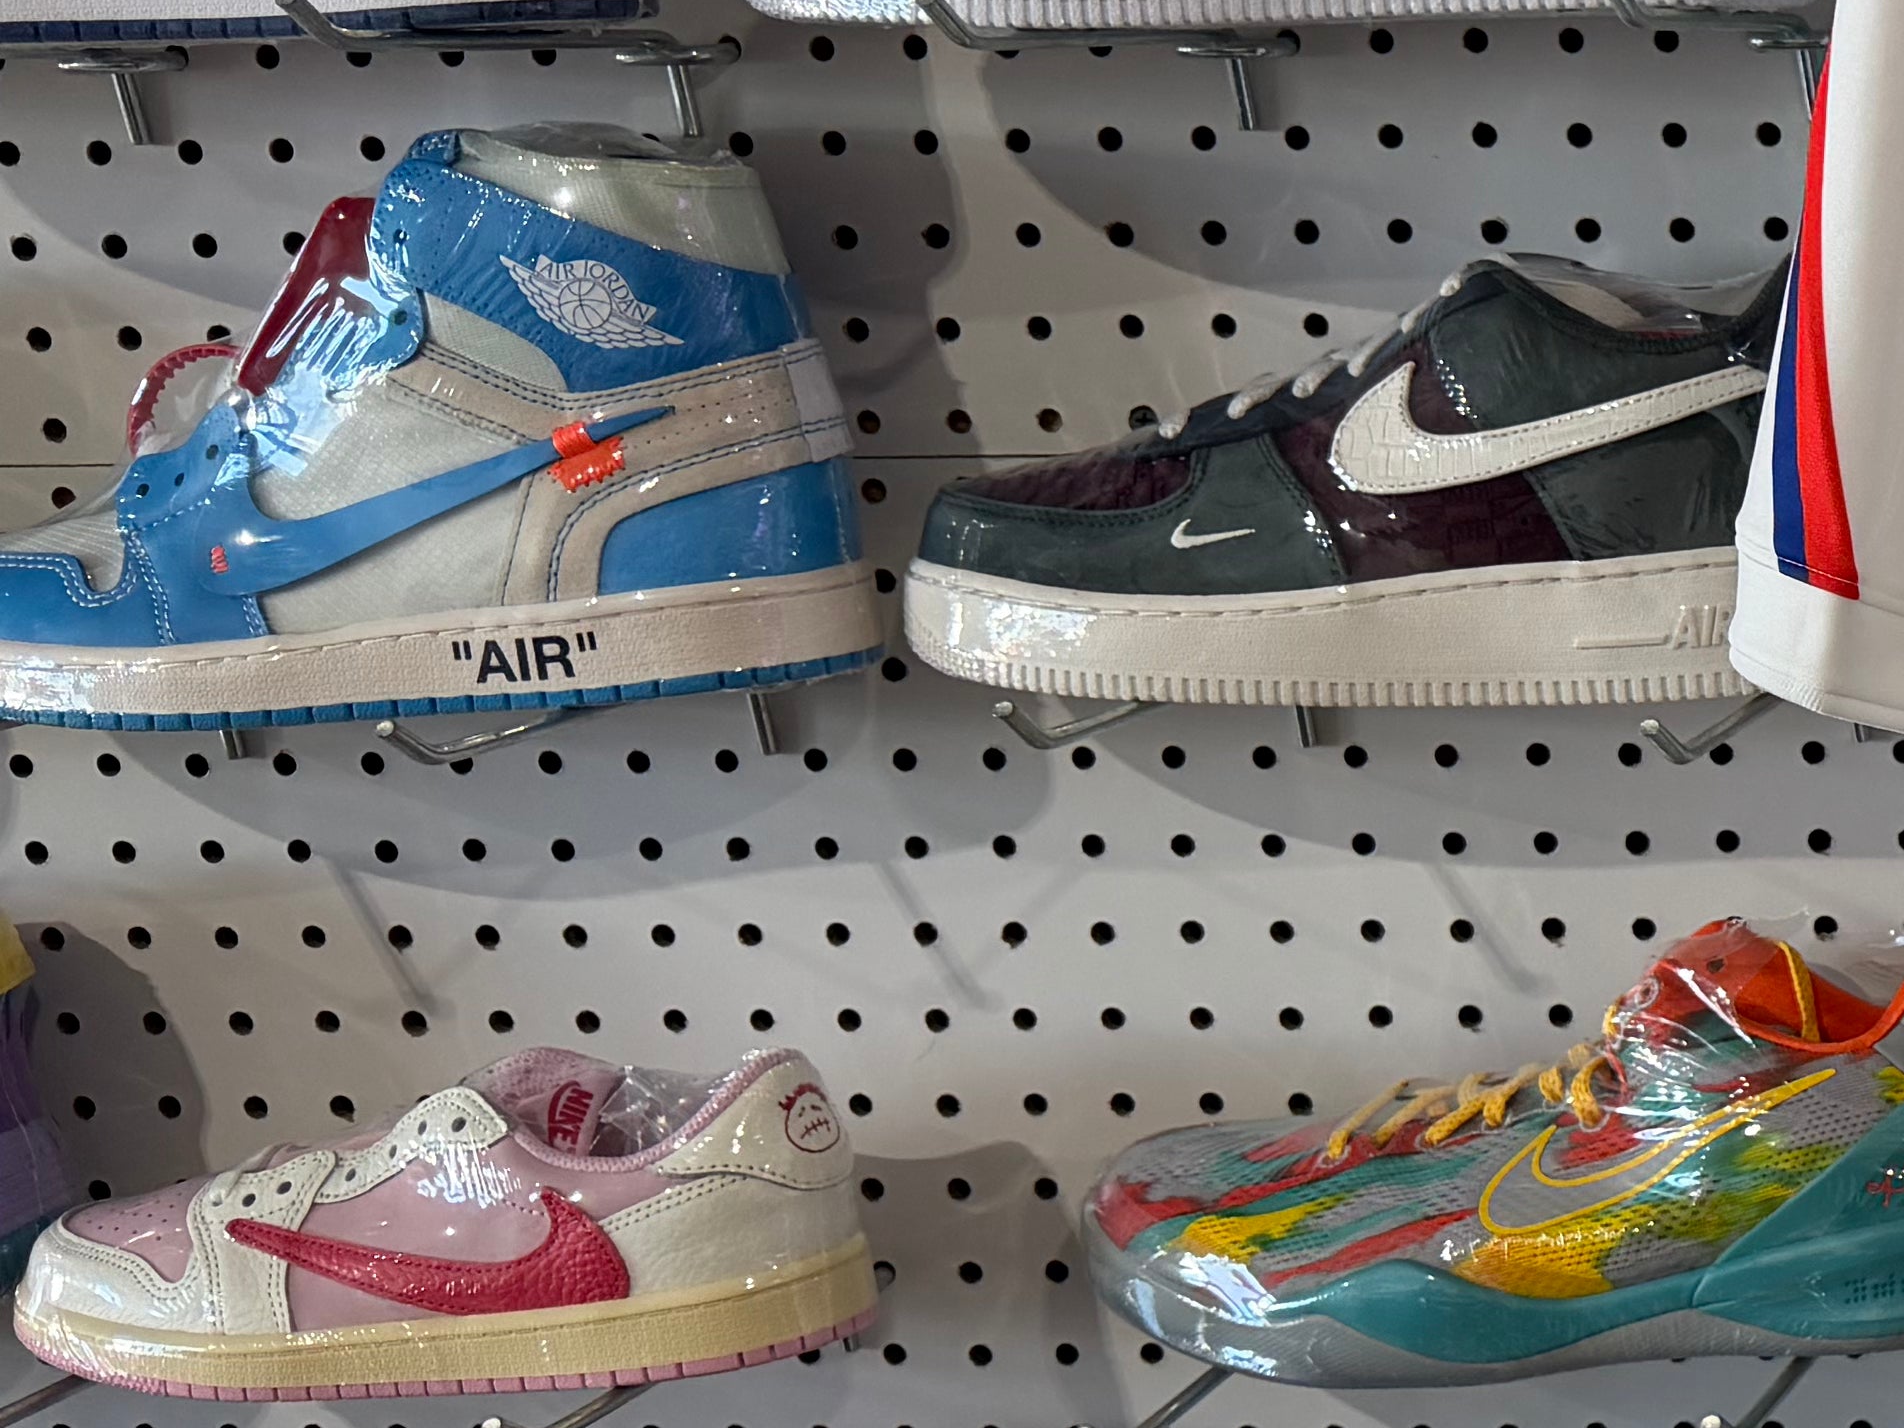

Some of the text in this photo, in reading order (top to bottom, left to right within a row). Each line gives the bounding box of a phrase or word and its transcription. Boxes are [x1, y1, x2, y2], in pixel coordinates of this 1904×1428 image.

[539, 259, 651, 322] AIR JORDAN
[451, 631, 598, 684] "AIR"
